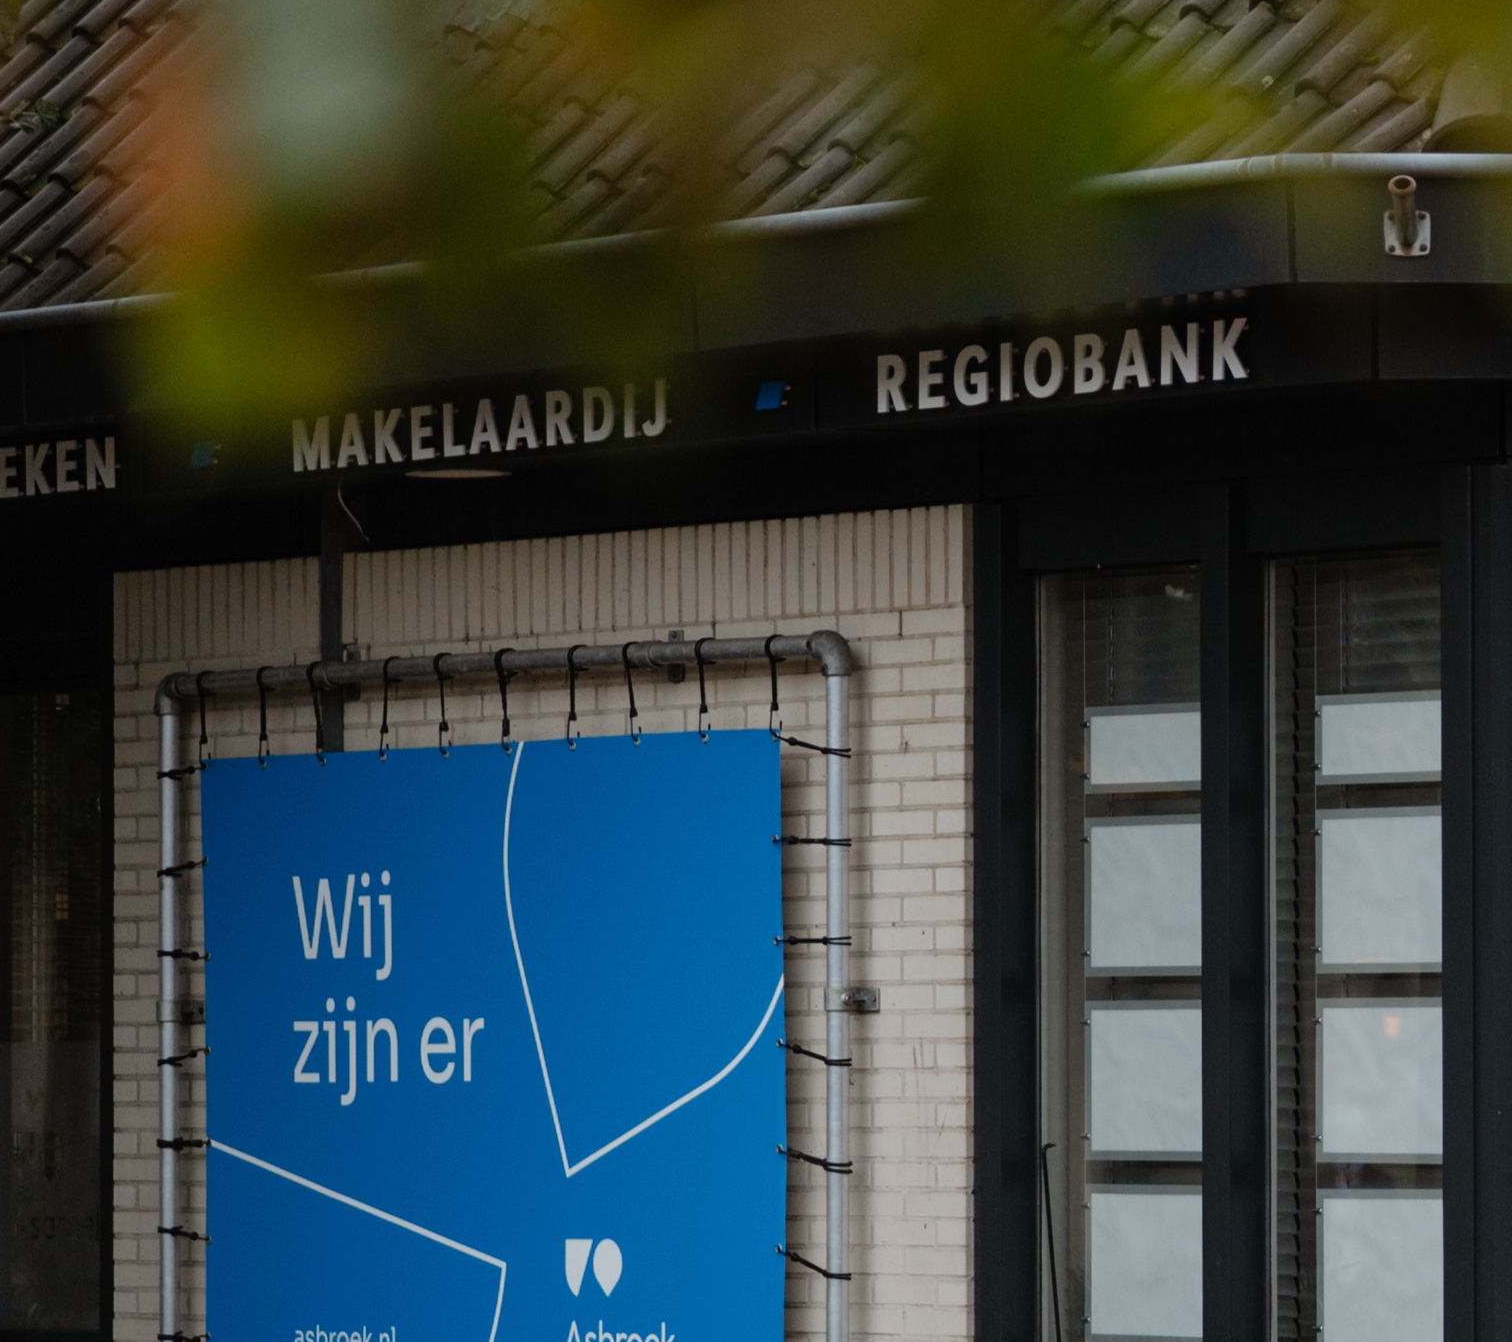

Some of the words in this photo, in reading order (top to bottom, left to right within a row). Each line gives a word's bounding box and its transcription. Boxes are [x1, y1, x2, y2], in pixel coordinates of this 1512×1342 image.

[290, 376, 671, 473] MAKELAARDIJ
[875, 316, 1249, 414] REGIOBANK
[292, 869, 393, 981] Wij
[292, 997, 399, 1107] zijn
[418, 1013, 485, 1085] er
